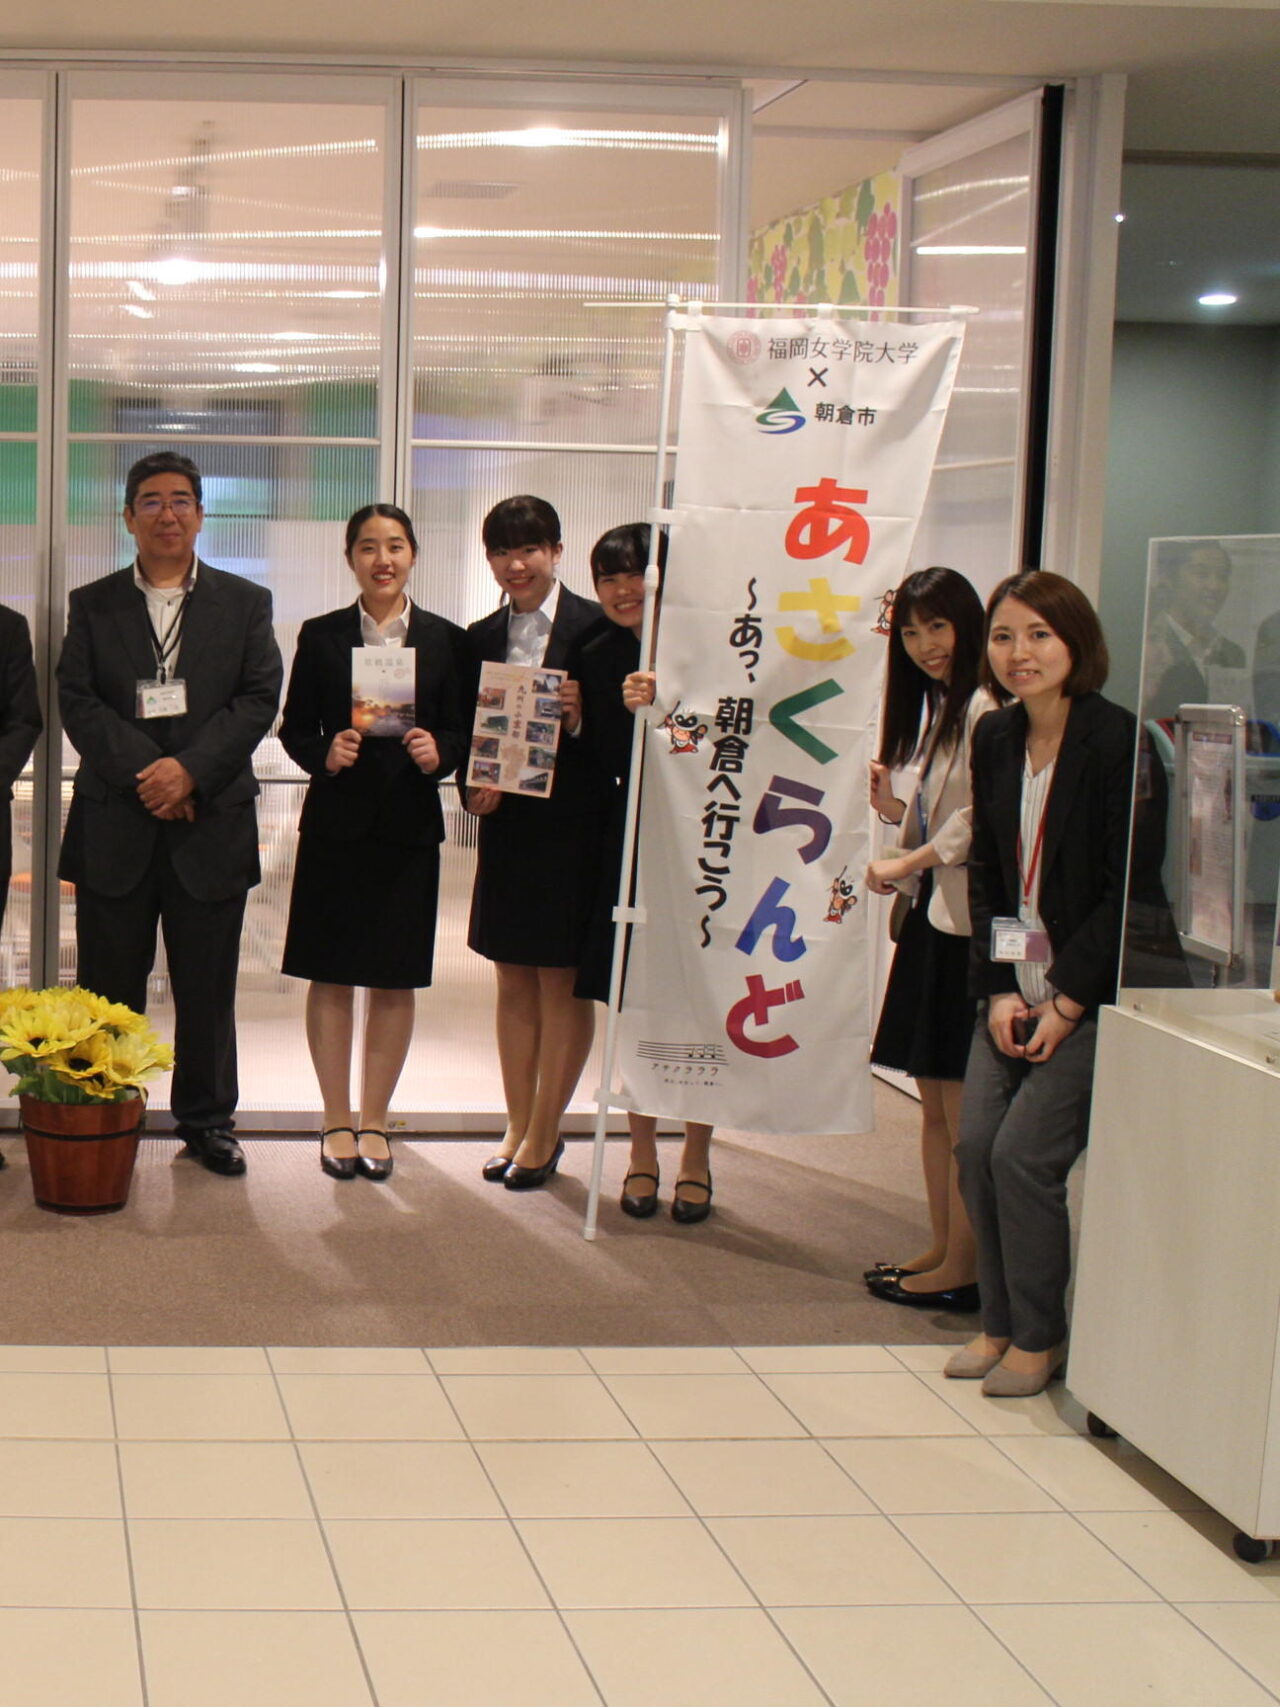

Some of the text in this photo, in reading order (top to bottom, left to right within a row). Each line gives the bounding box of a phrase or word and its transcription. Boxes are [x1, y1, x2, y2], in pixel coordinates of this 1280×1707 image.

[767, 336, 920, 365] 福岡女学院大学
[814, 402, 878, 427] 朝倉市
[725, 477, 872, 1059] あさくらんど
